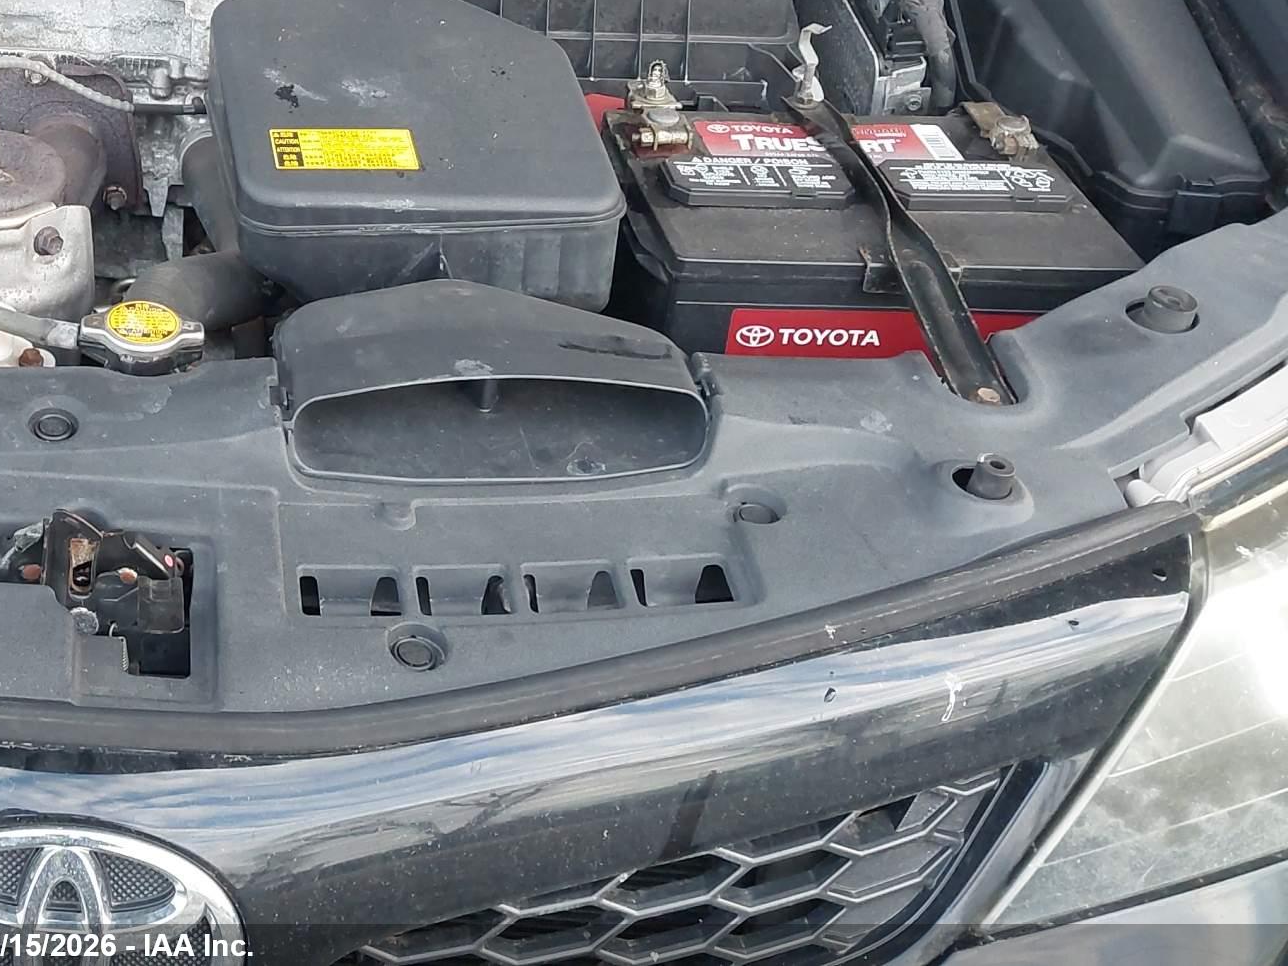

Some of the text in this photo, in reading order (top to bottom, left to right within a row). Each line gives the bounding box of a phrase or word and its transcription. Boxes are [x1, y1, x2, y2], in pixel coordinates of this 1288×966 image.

[731, 124, 793, 134] TOYOTA
[703, 156, 752, 164] DANGER
[763, 158, 809, 166] POISON
[778, 328, 881, 346] TOYOTA
